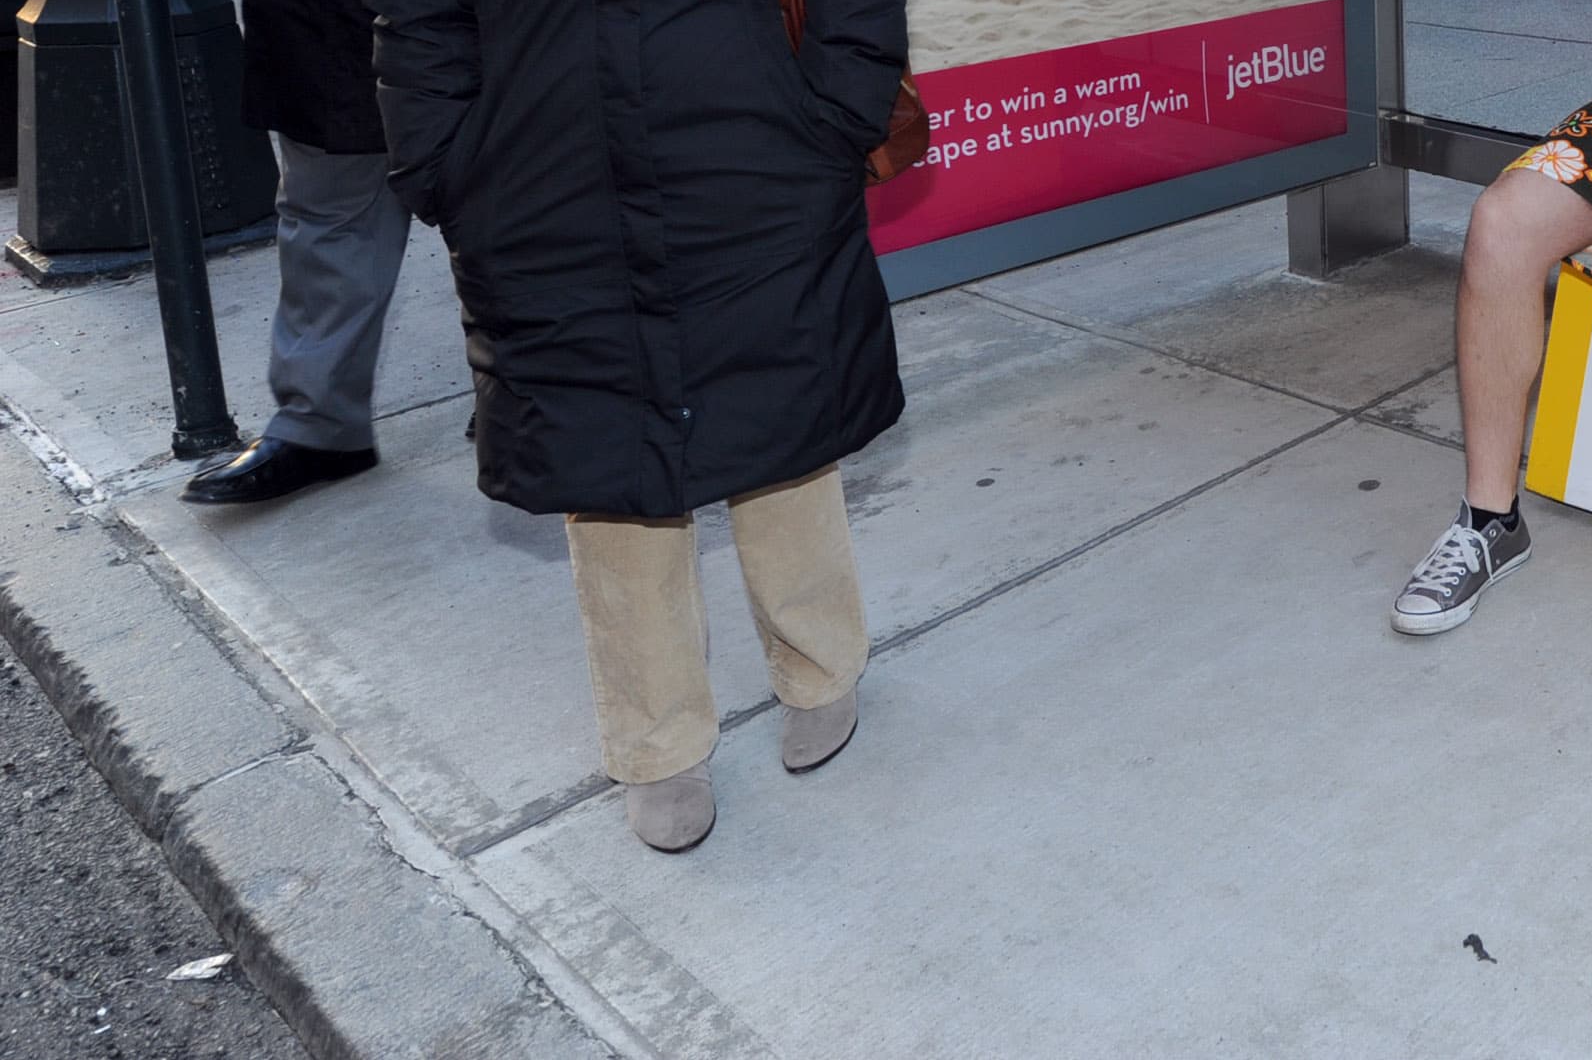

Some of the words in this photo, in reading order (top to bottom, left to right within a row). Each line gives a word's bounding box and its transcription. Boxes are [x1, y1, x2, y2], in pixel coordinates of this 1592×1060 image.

[963, 97, 993, 123] to
[1000, 86, 1046, 115] win
[1053, 87, 1068, 106] a
[1075, 71, 1142, 101] warm
[1226, 45, 1326, 100] jetBlue
[912, 138, 978, 169] ape
[986, 123, 1014, 152] at
[1020, 89, 1190, 144] sunny.org/win
